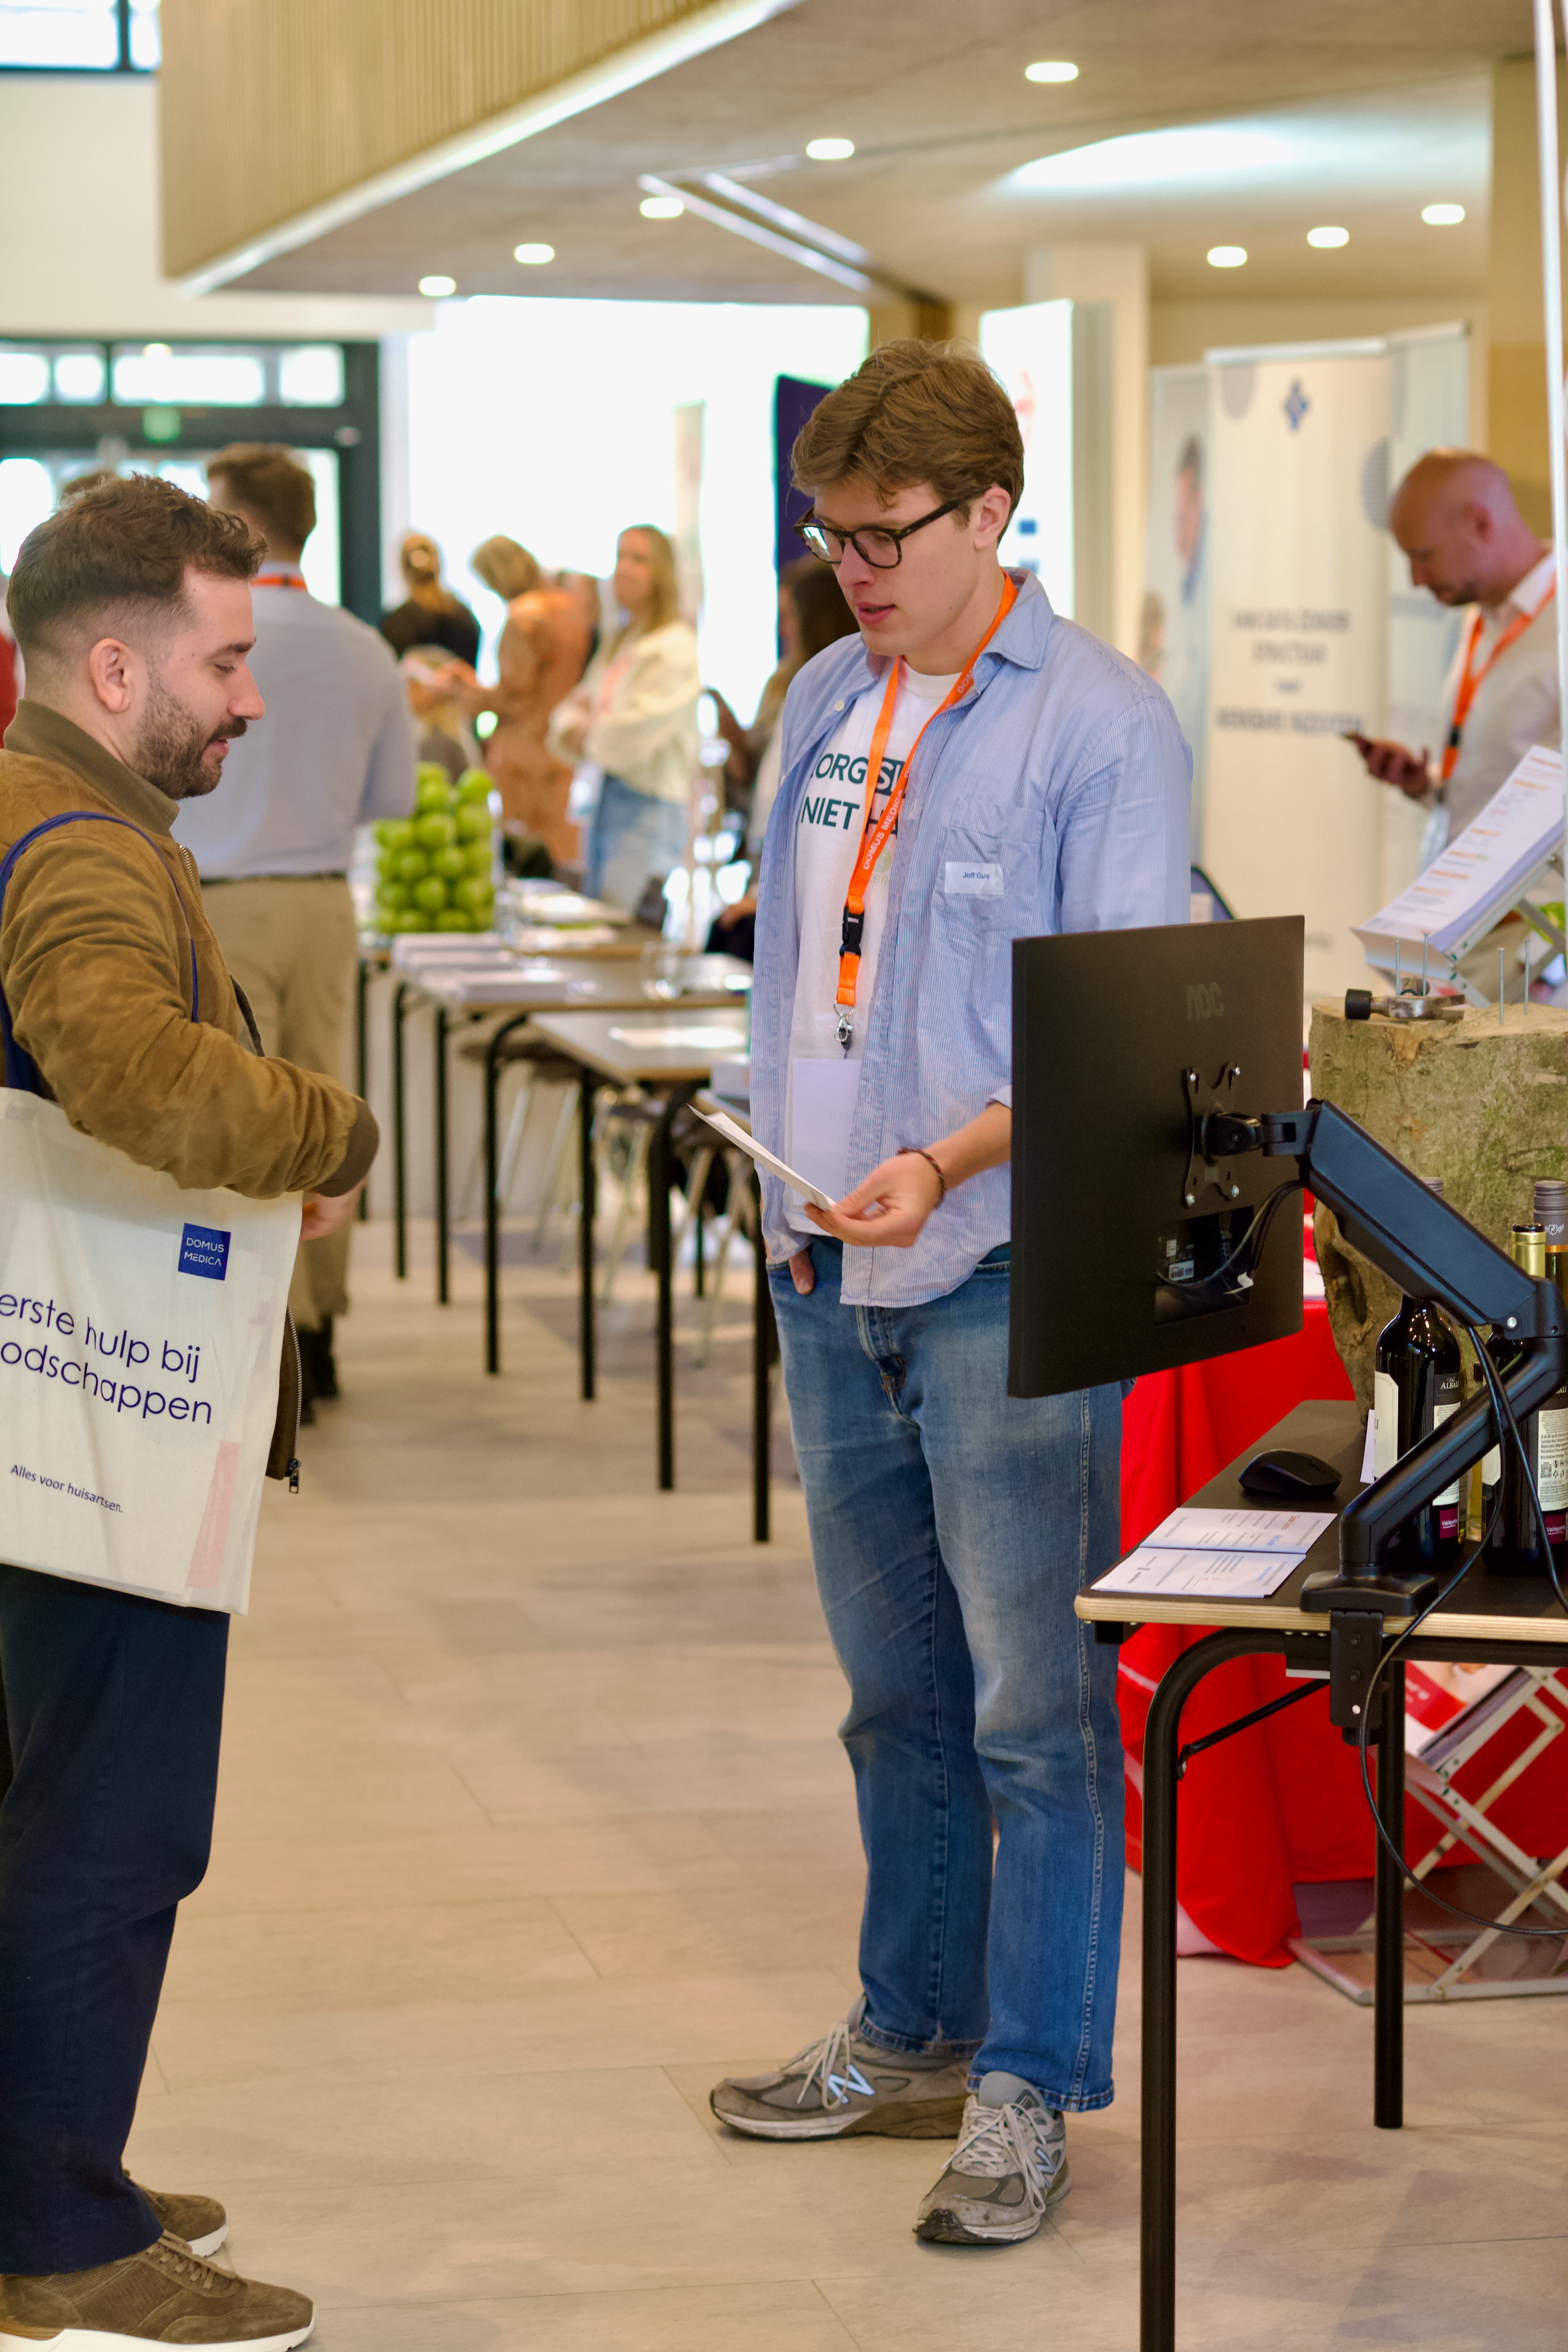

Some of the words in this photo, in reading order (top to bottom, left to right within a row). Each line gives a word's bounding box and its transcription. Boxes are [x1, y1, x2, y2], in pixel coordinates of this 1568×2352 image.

[810, 753, 869, 784] ORG
[801, 797, 860, 830] NIET
[863, 831, 885, 870] DOMUS
[881, 789, 903, 830] MEDICA
[184, 1251, 221, 1267] MEDICA
[186, 1237, 225, 1252] DOMUS
[85, 1316, 150, 1367] hulp
[161, 1341, 201, 1383] bij
[0, 1342, 212, 1424] odschappen
[1440, 1380, 1459, 1390] ALBALI
[11, 1465, 36, 1482] Alles
[40, 1475, 65, 1490] voor
[67, 1483, 123, 1513] huisartsen.
